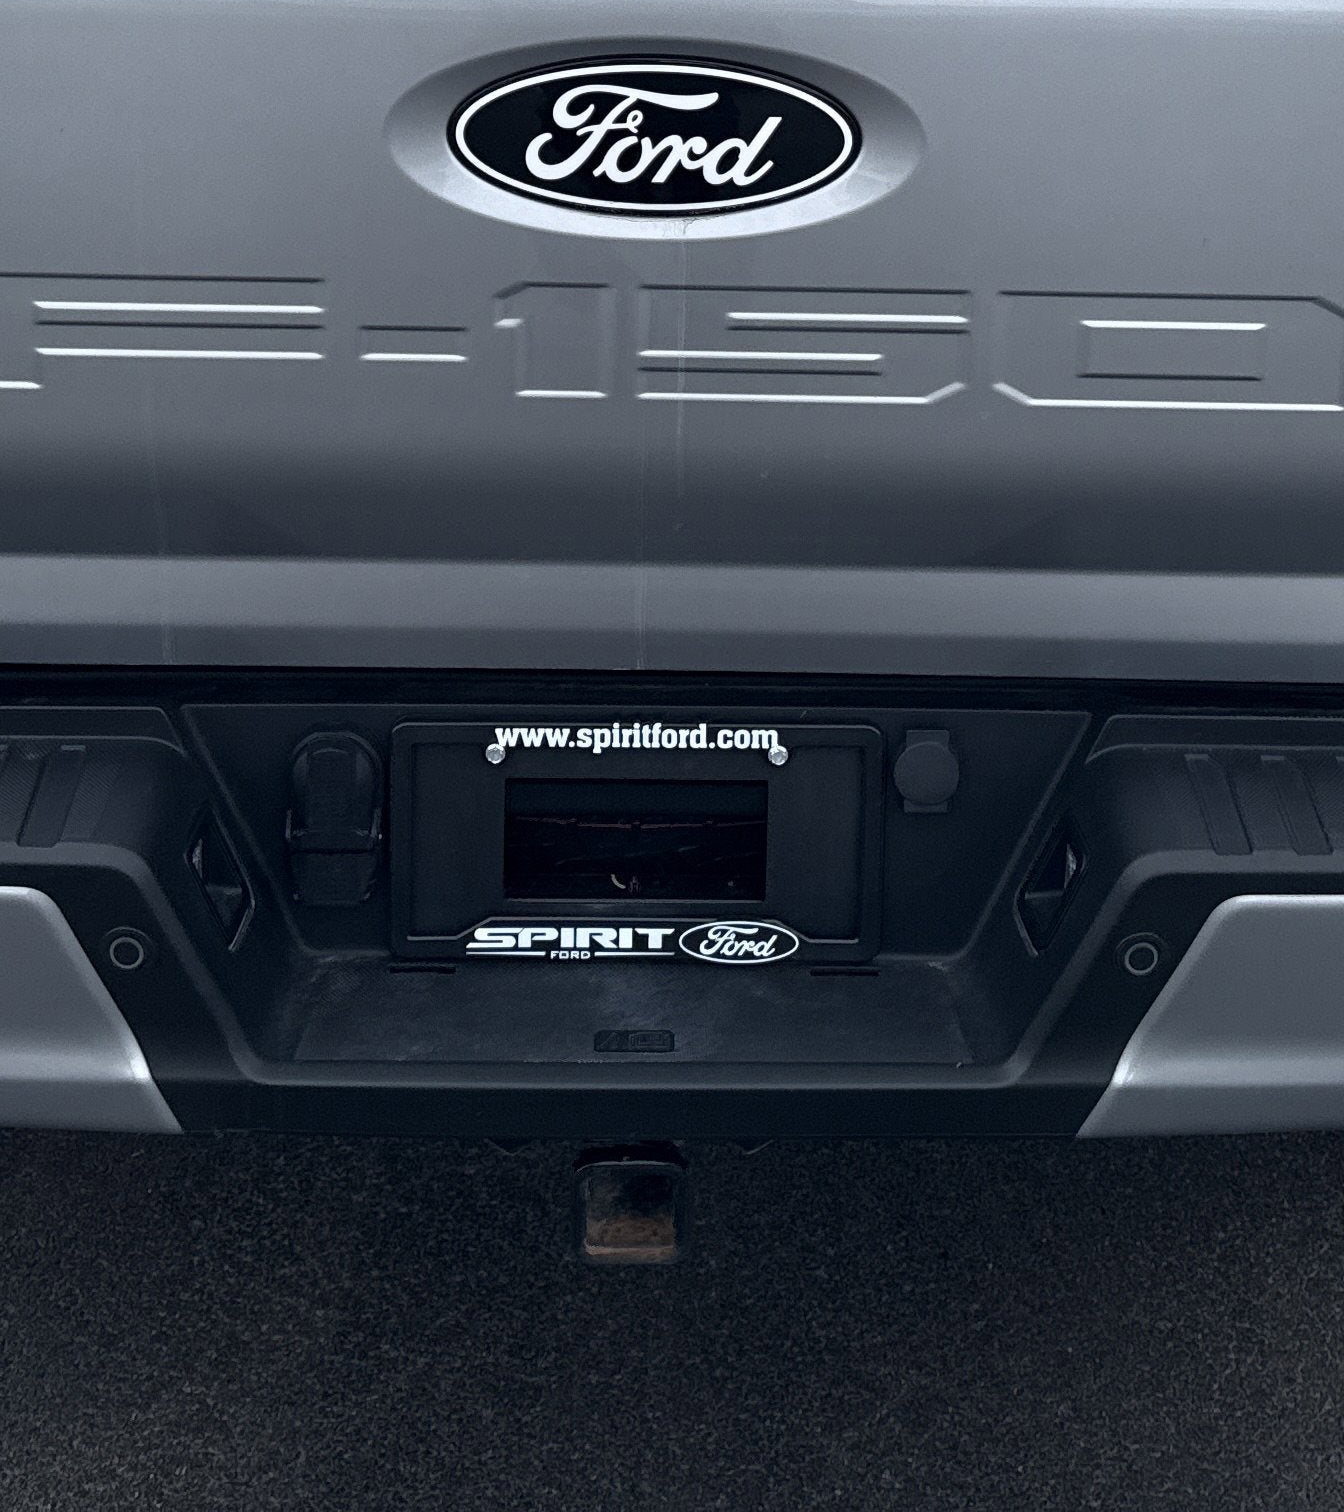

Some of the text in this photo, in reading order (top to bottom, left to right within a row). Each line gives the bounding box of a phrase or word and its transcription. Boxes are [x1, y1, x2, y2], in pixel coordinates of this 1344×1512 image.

[524, 82, 784, 192] Ford
[495, 722, 780, 753] www.spiritford.com
[466, 924, 775, 958] SPIRIT Ford
[550, 950, 591, 960] FORD
